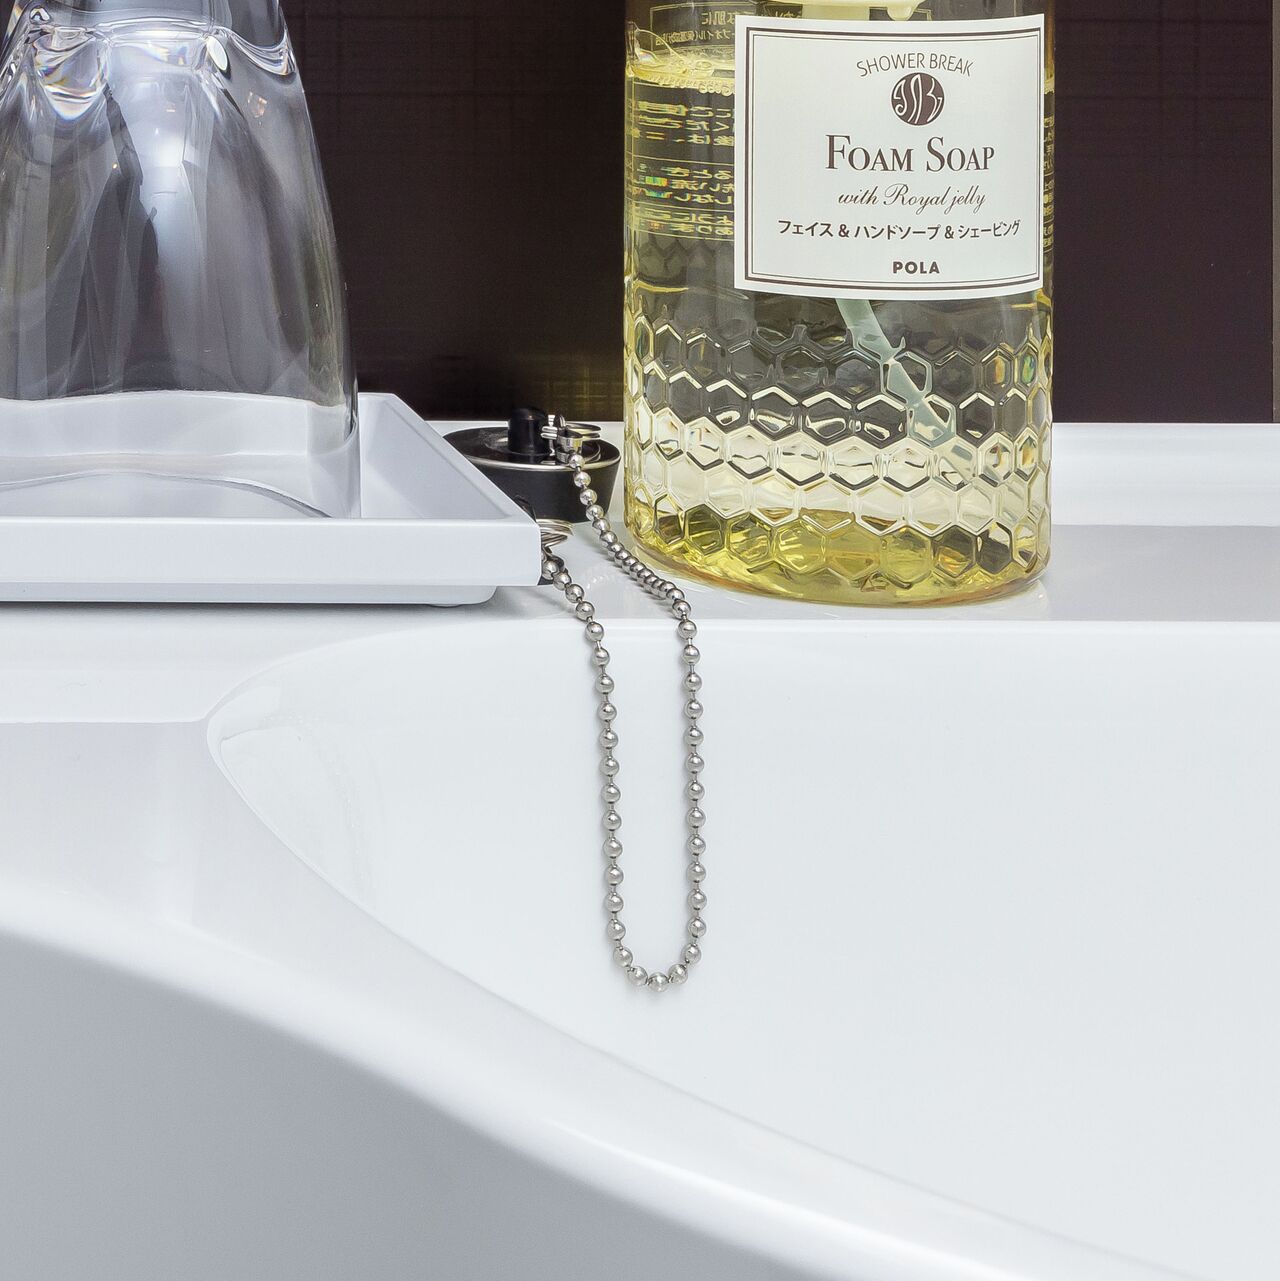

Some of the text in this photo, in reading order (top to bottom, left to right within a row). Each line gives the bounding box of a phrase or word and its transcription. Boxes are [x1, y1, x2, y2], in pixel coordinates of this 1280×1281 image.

[857, 53, 974, 78] SHOWER BREAK
[825, 134, 995, 172] FOAM SOAP
[838, 183, 987, 215] with Royal jelly
[778, 219, 1021, 240] フェイス & ハンドソープ & シェービング
[892, 261, 940, 274] POLA
